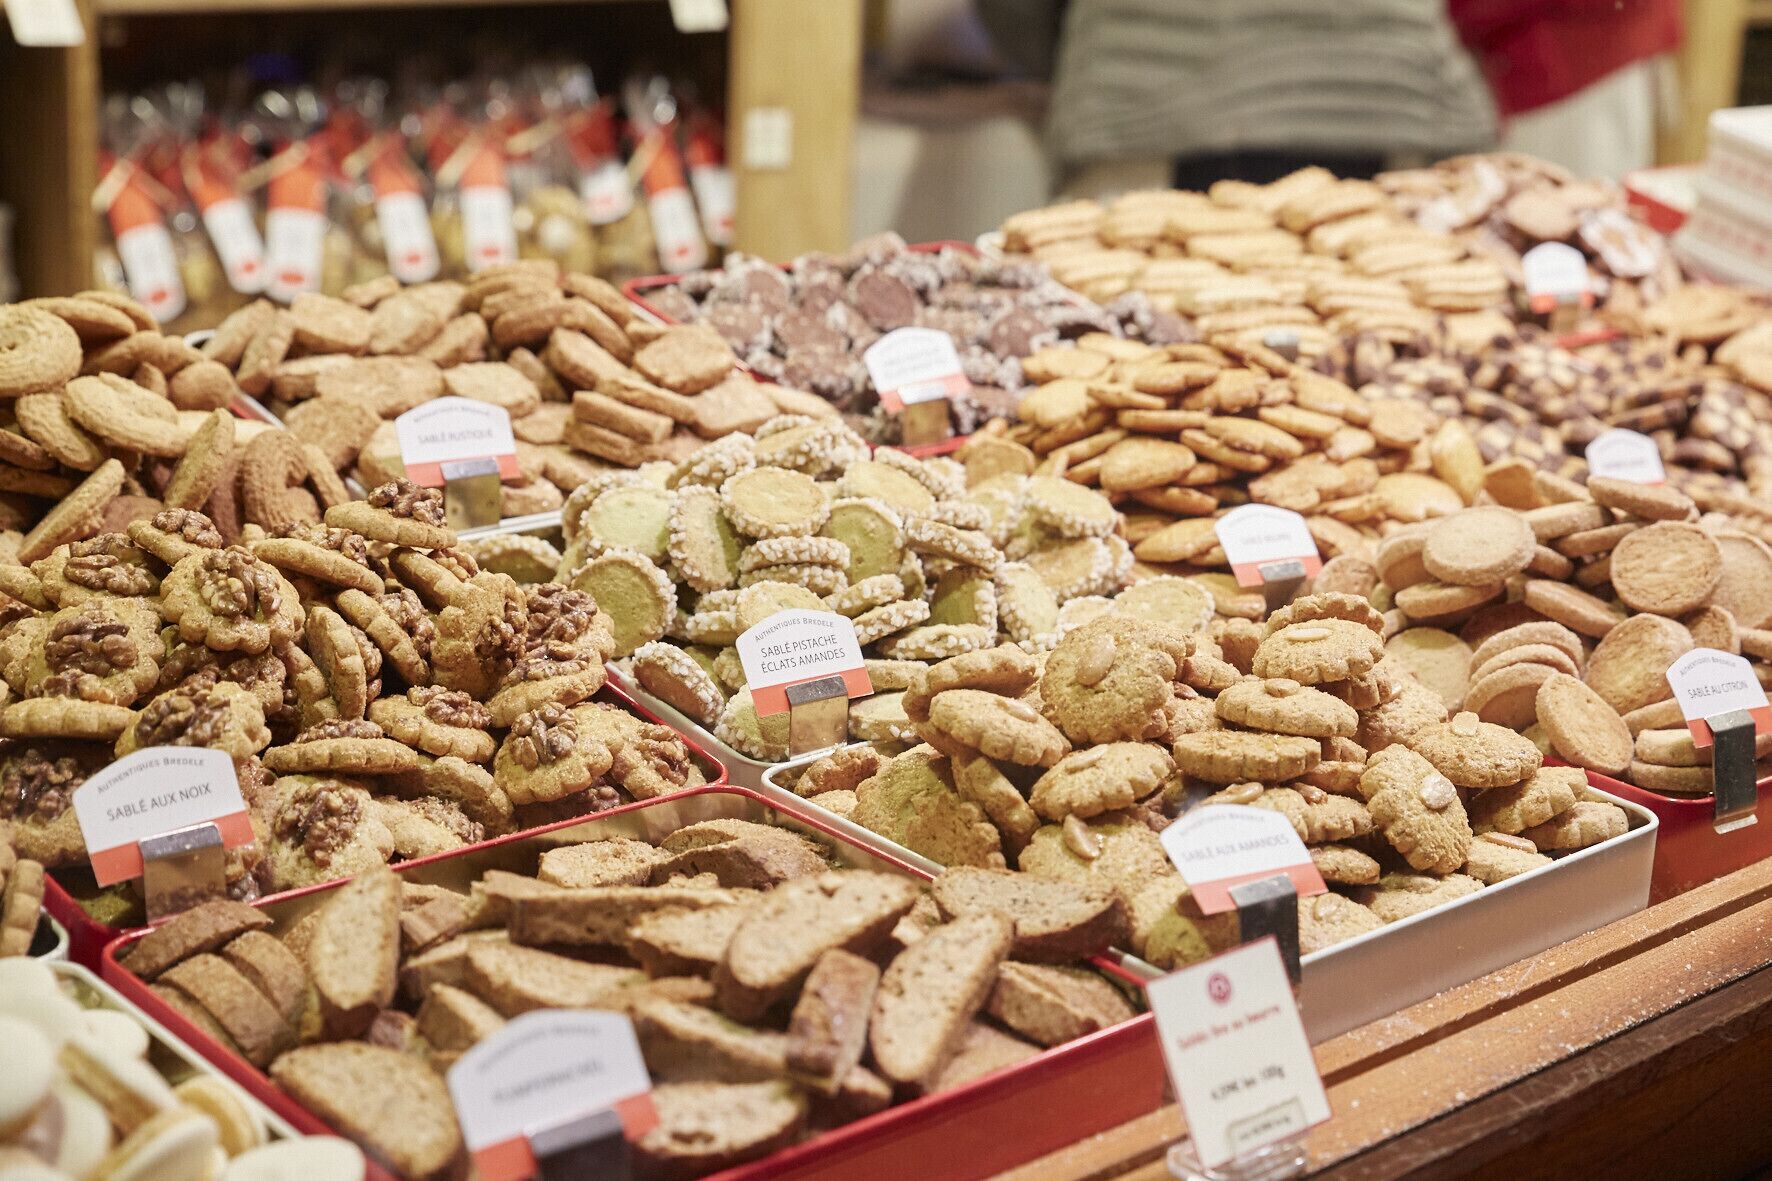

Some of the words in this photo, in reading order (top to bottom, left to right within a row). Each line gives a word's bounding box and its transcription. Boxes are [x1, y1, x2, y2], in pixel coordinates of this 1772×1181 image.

[755, 618, 801, 642] AUTHENTIQUES
[760, 642, 792, 658] SABLÉ
[792, 634, 838, 652] PISTACHE
[761, 657, 797, 674] ÉCLATS
[799, 647, 846, 666] AMANDES
[97, 758, 161, 794] AUTHENTIQUES
[162, 757, 206, 767] BREDELE
[106, 798, 148, 822] SABLÉ
[150, 793, 177, 809] AUX
[178, 782, 212, 801] NOIX
[1238, 833, 1290, 851] AMANDES
